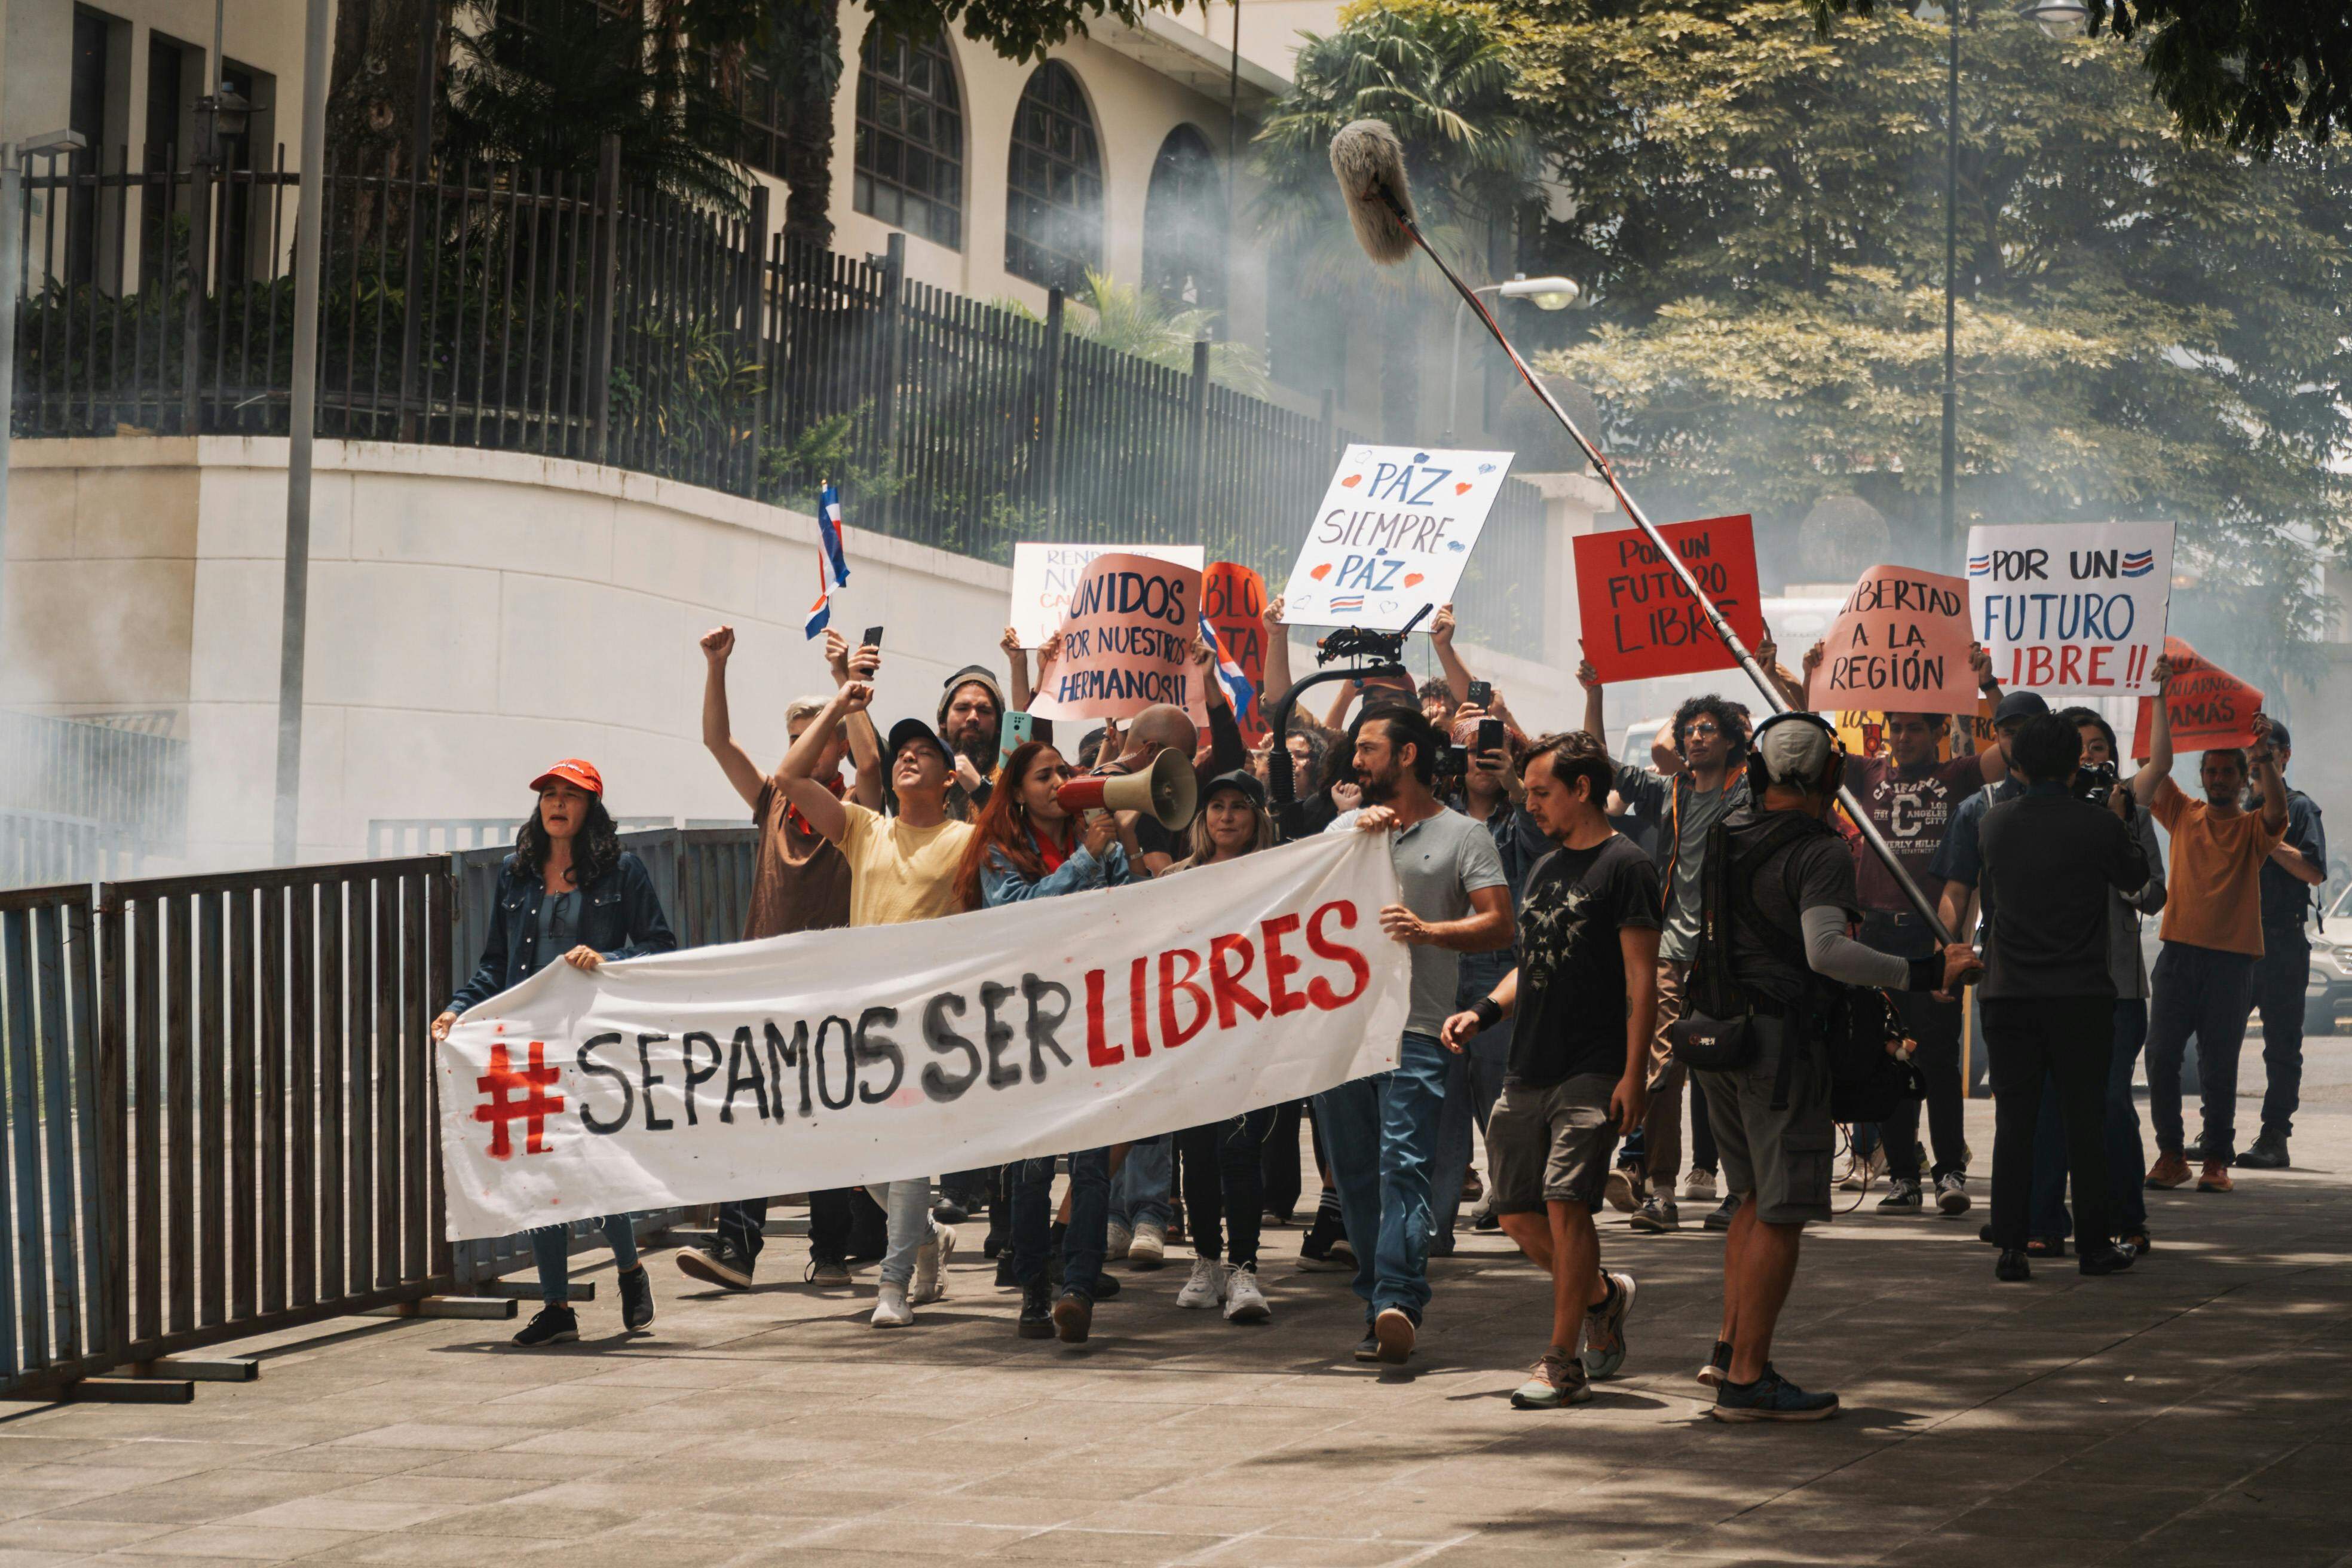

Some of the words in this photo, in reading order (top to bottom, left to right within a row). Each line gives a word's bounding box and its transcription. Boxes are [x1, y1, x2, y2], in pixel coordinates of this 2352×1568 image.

[1318, 509, 1454, 555] SIEMPRE
[1679, 532, 1710, 559] UN
[1993, 549, 2048, 581] POR
[2070, 549, 2118, 580] UN
[1070, 572, 1185, 625] UNIDOS
[1984, 593, 2134, 641] FUTURO
[1065, 627, 1089, 663] POR
[1098, 626, 1187, 665] NUESTROS
[1852, 623, 1869, 650] A
[1888, 623, 1927, 649] LA
[1830, 650, 1943, 691] REGIÓN
[2169, 694, 2235, 727] AMÁS
[1892, 794, 1922, 837] C
